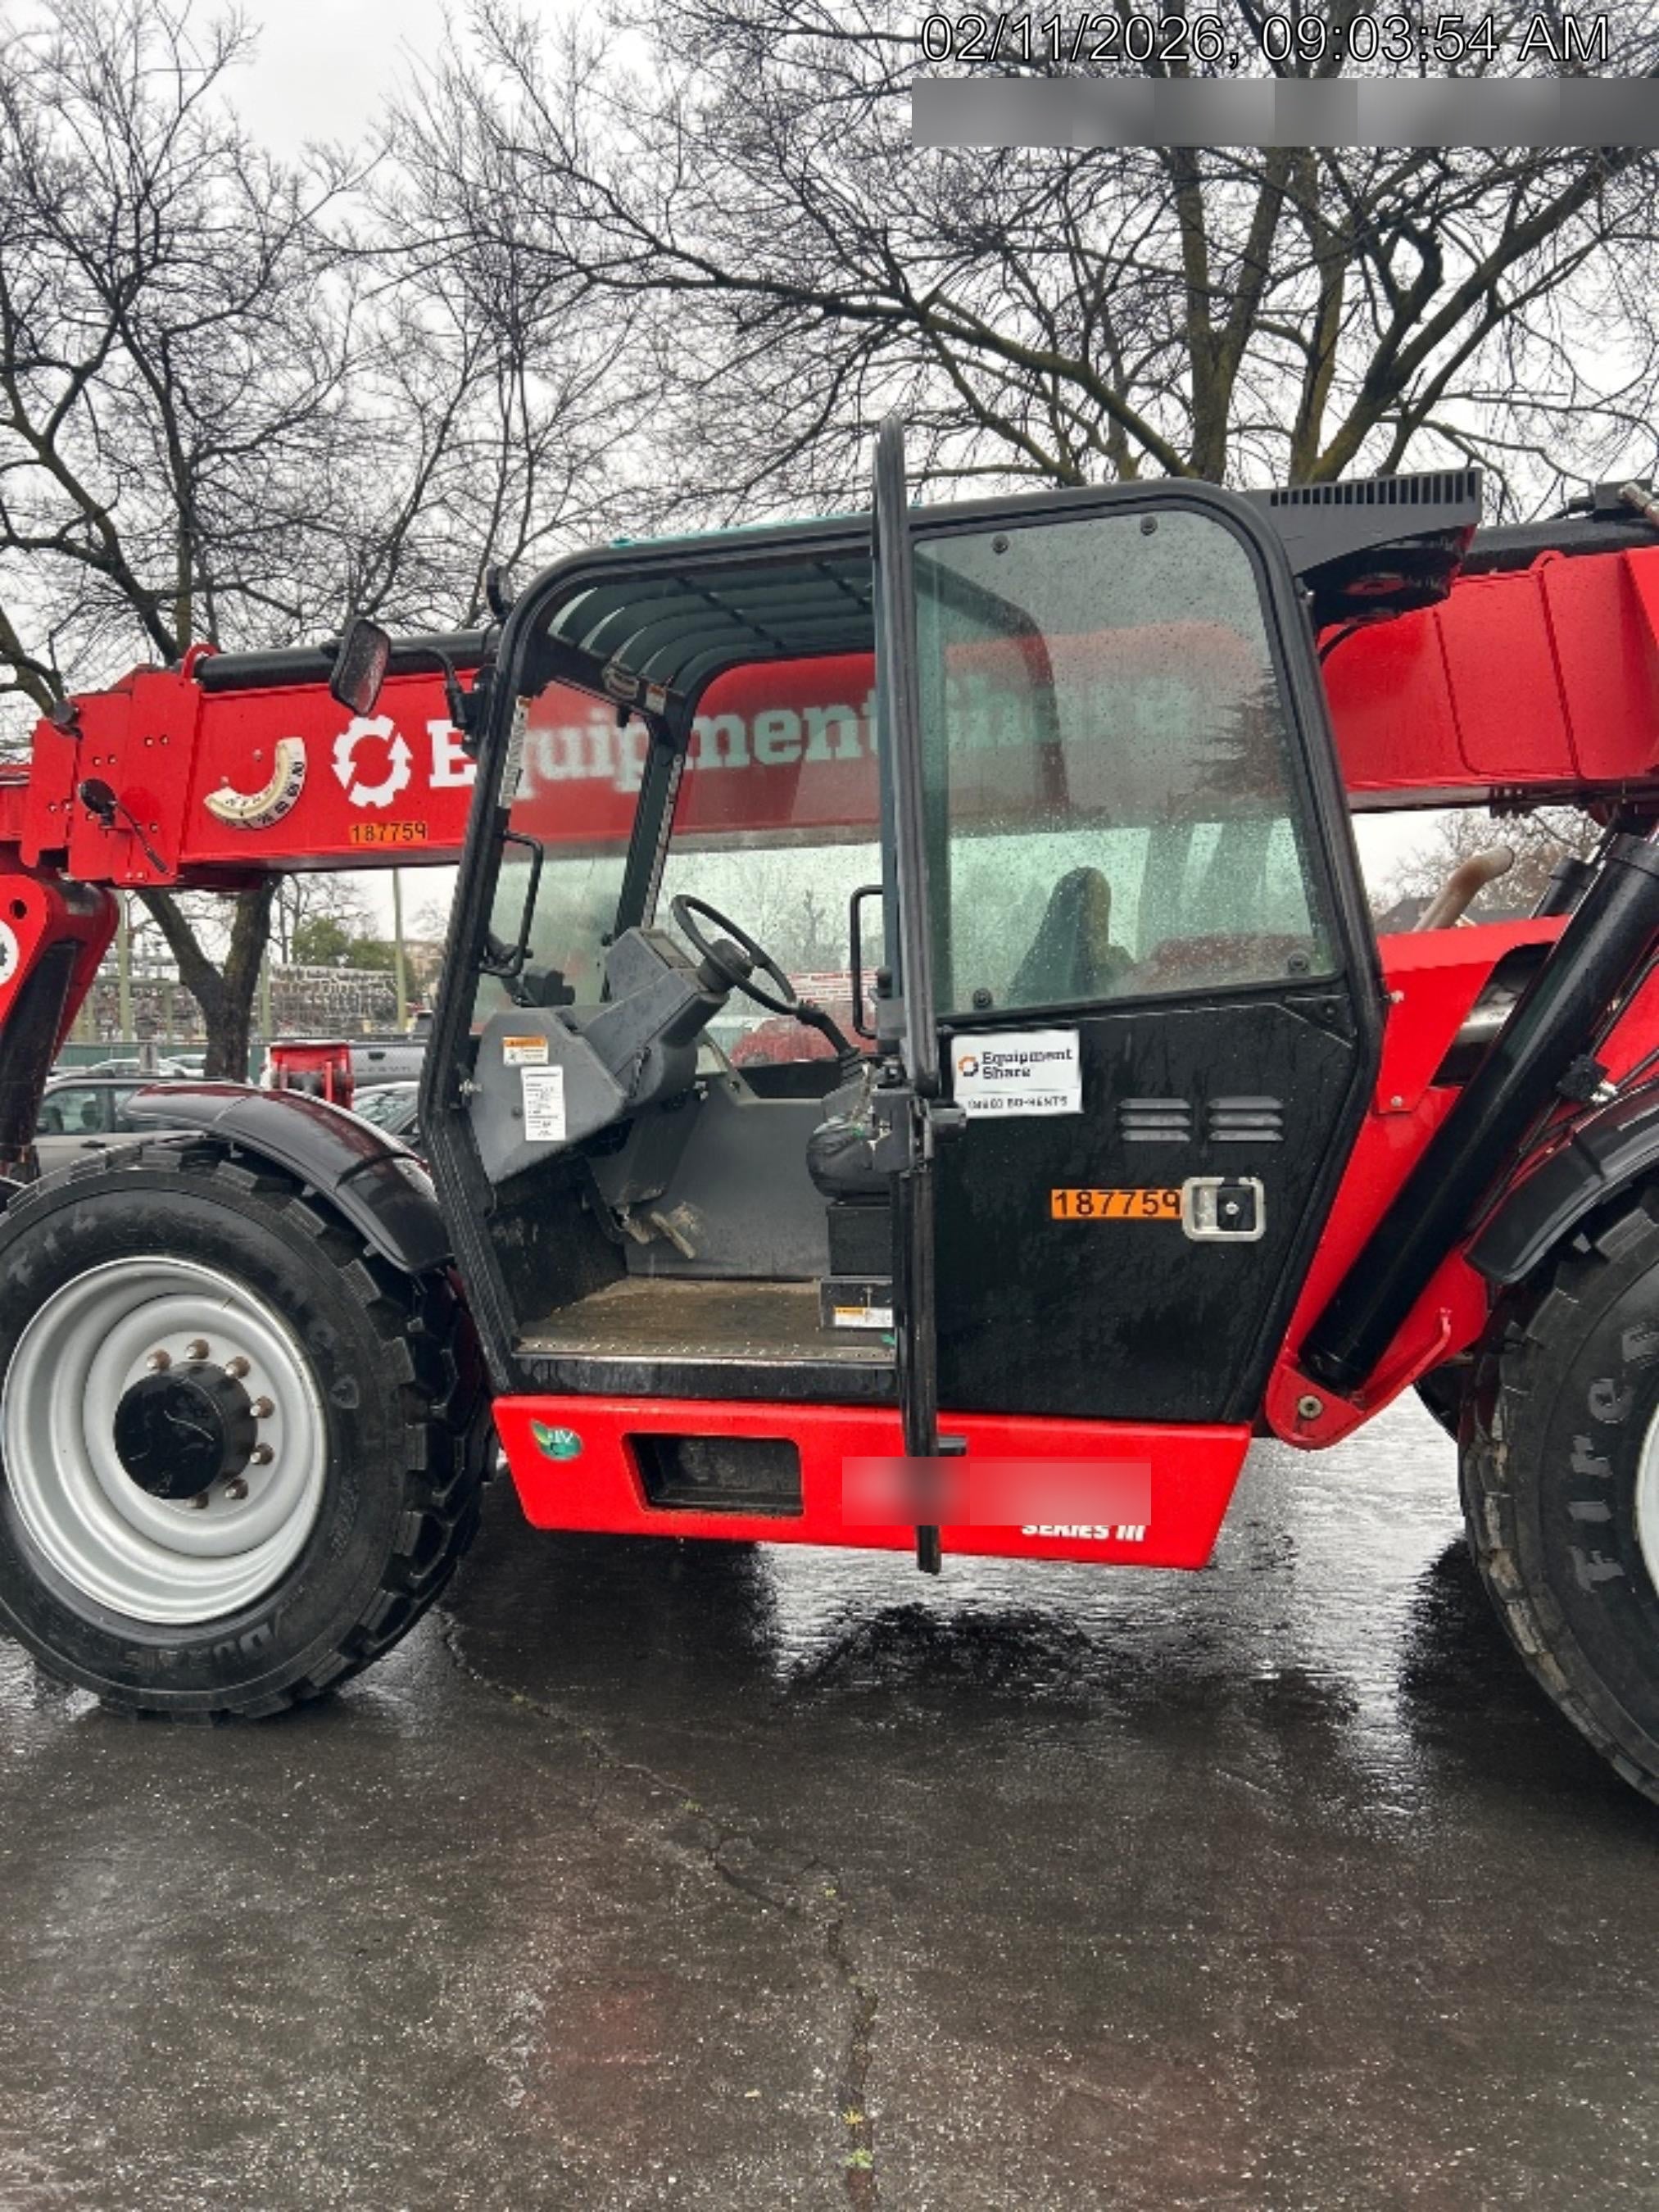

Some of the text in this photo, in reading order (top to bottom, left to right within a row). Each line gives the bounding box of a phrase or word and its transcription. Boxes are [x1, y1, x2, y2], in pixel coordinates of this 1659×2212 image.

[352, 821, 426, 845] 187759
[981, 1047, 1073, 1067] Equipment
[1054, 1190, 1181, 1217] 187759
[1021, 1525, 1146, 1542] SERIES III
